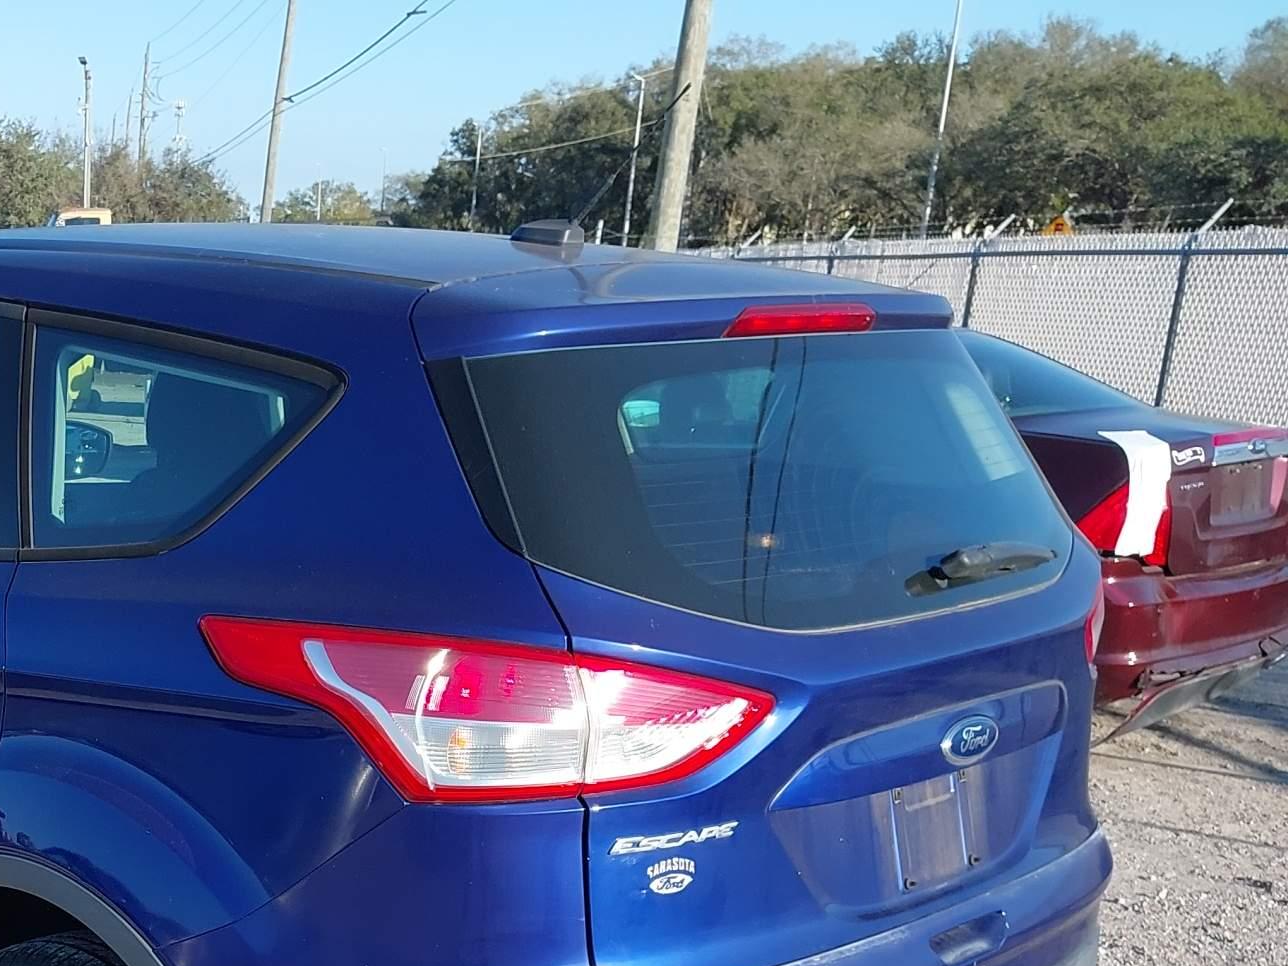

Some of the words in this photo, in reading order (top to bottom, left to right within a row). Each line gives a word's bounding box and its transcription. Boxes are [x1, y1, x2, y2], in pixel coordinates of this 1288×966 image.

[961, 725, 990, 752] Ford
[608, 820, 739, 856] ESCAPE
[647, 857, 696, 879] SARASOTA
[656, 875, 686, 891] Ford
